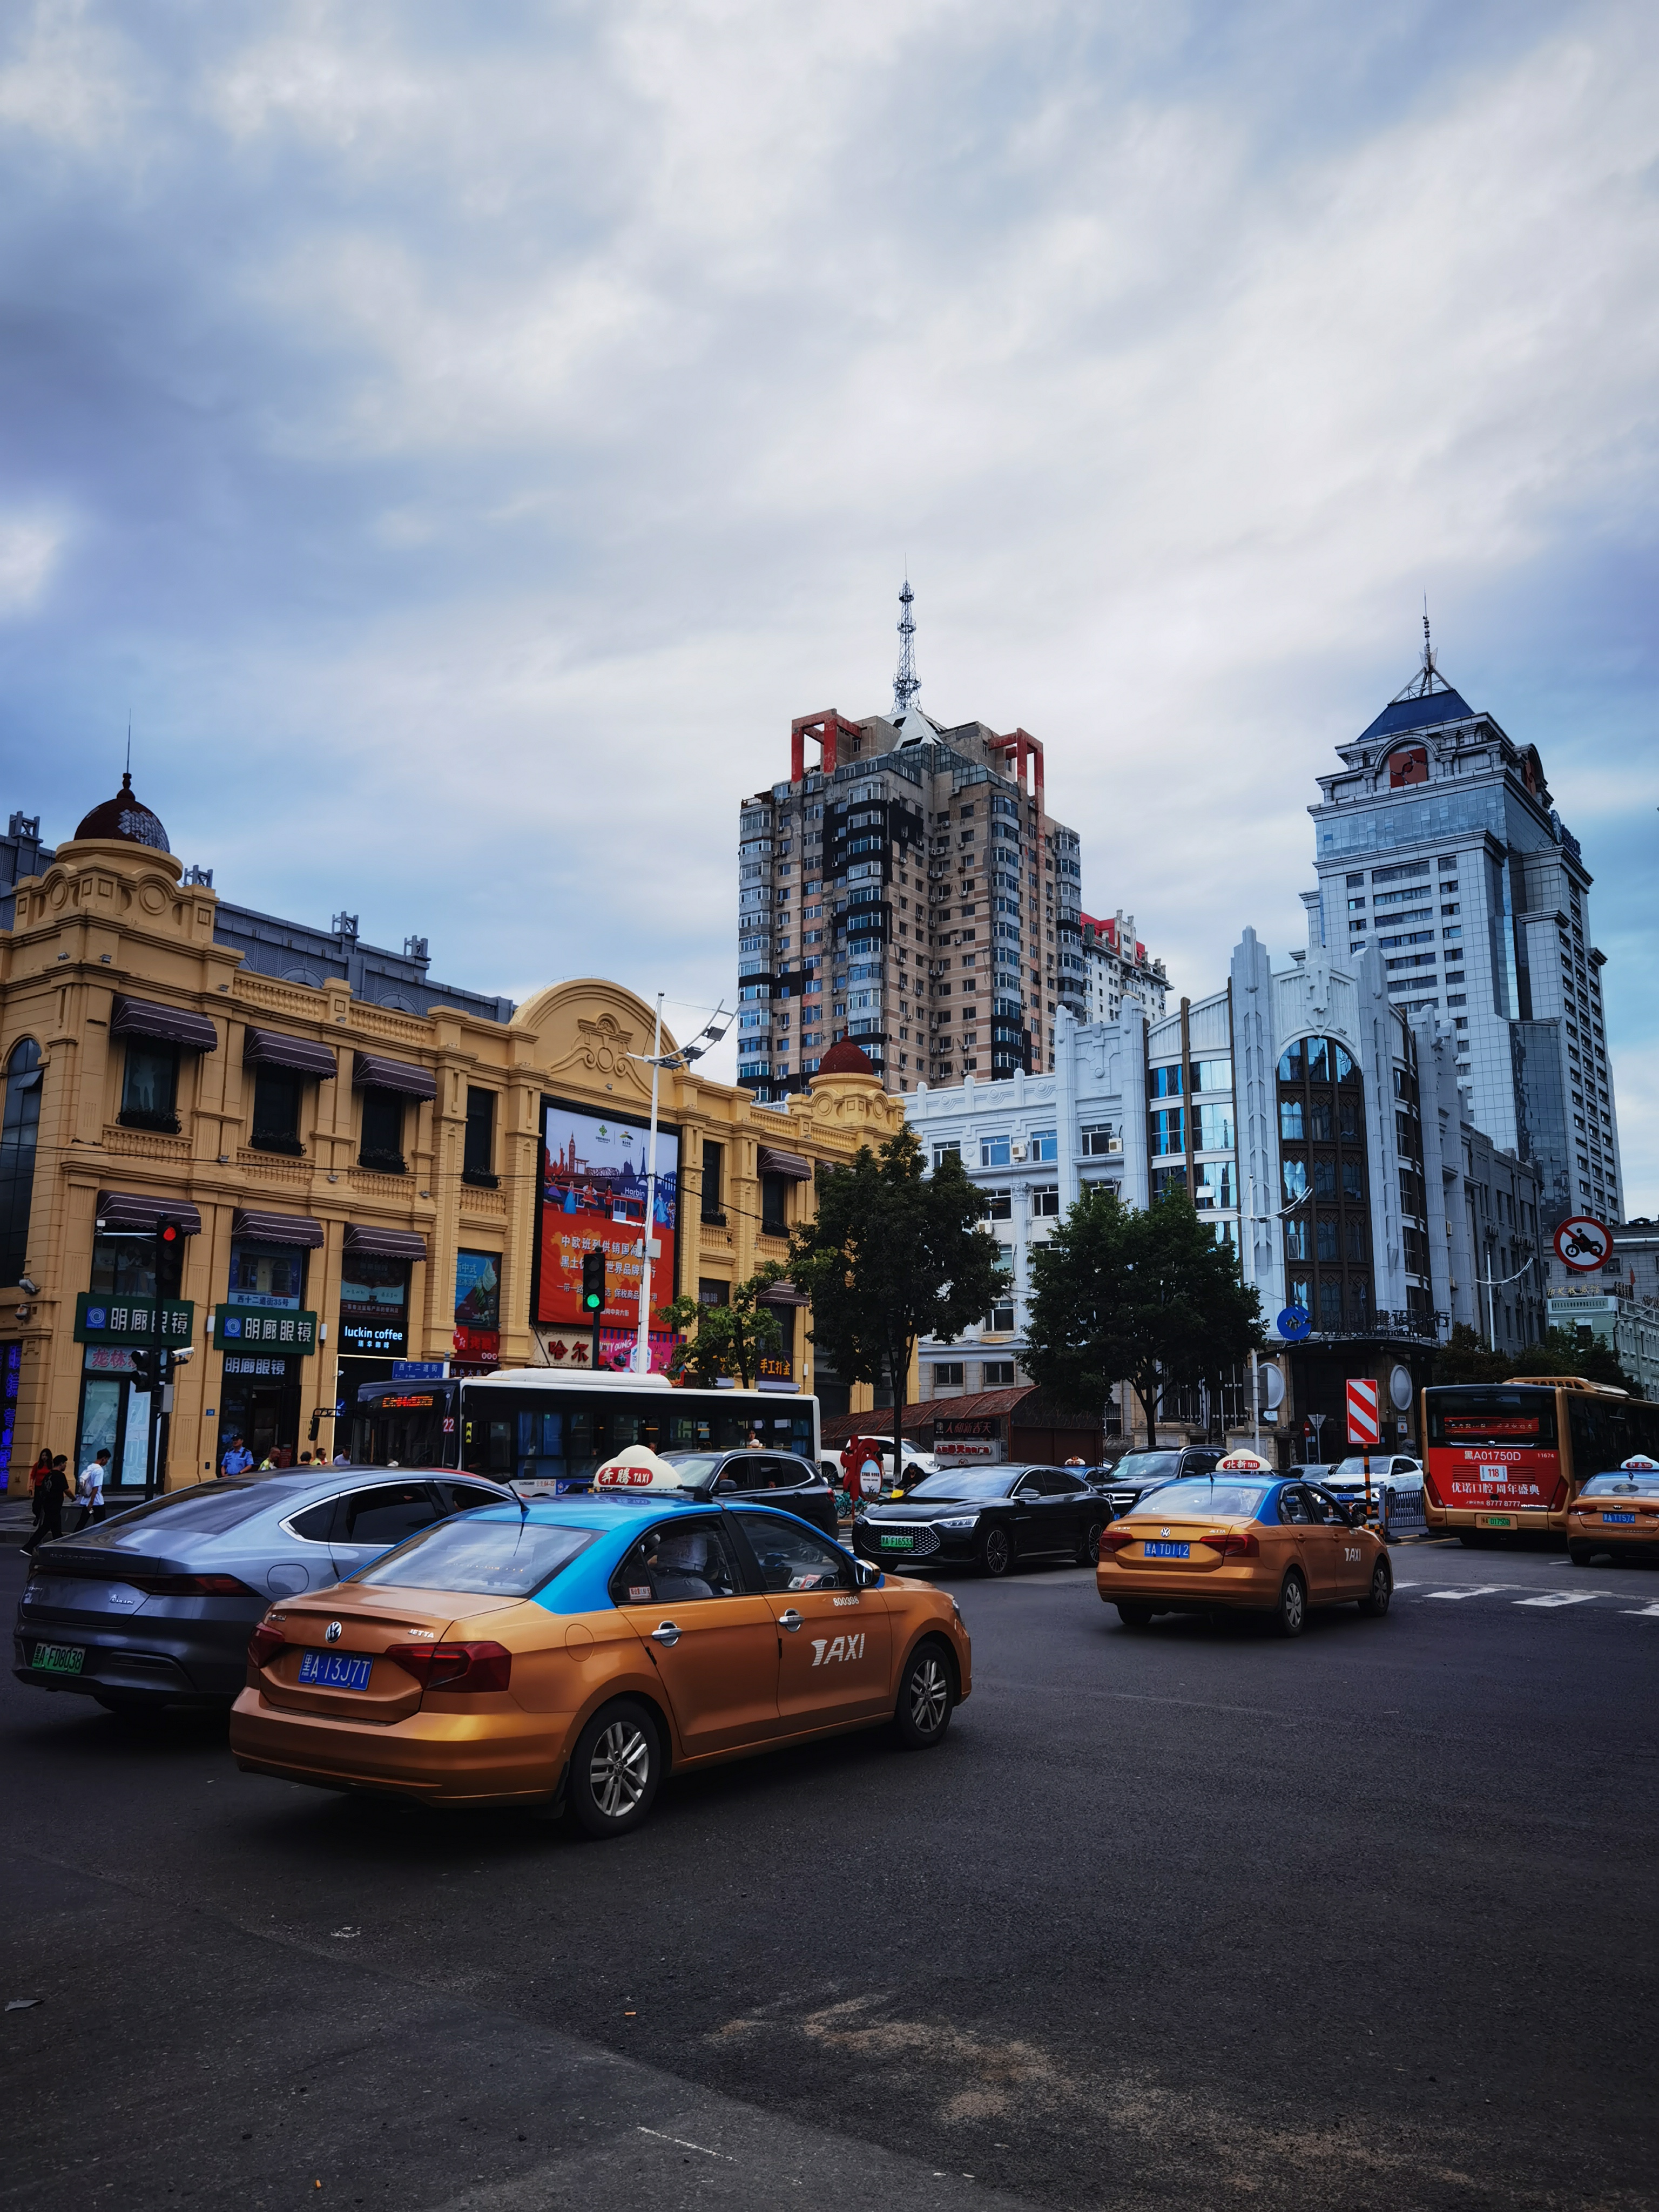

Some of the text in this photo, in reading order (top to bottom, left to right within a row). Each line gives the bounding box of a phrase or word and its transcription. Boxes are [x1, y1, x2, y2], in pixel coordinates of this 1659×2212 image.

[625, 1187, 645, 1197] Harbin
[237, 1295, 289, 1307] 西十二道街35号
[245, 1318, 312, 1342] 明廊眼镜
[345, 1325, 403, 1340] luckin coffee
[358, 1340, 389, 1349] 瑞幸咖啡
[225, 1357, 286, 1375] 明廊眼镜
[399, 1363, 438, 1373] 西十二道街
[760, 1358, 791, 1375] 手工打金
[443, 1418, 454, 1432] 22
[1464, 1450, 1521, 1461] 黑A01750D
[1226, 1459, 1247, 1469] 北新
[601, 1467, 650, 1485] 奔腾 TAXI
[1488, 1468, 1499, 1477] 118
[1452, 1482, 1540, 1495] 优诺口腔 周年盛典
[1344, 1547, 1361, 1562] TAXI
[833, 1595, 860, 1607] 800398
[408, 1628, 435, 1638] JETTA
[811, 1633, 865, 1667] TAXI
